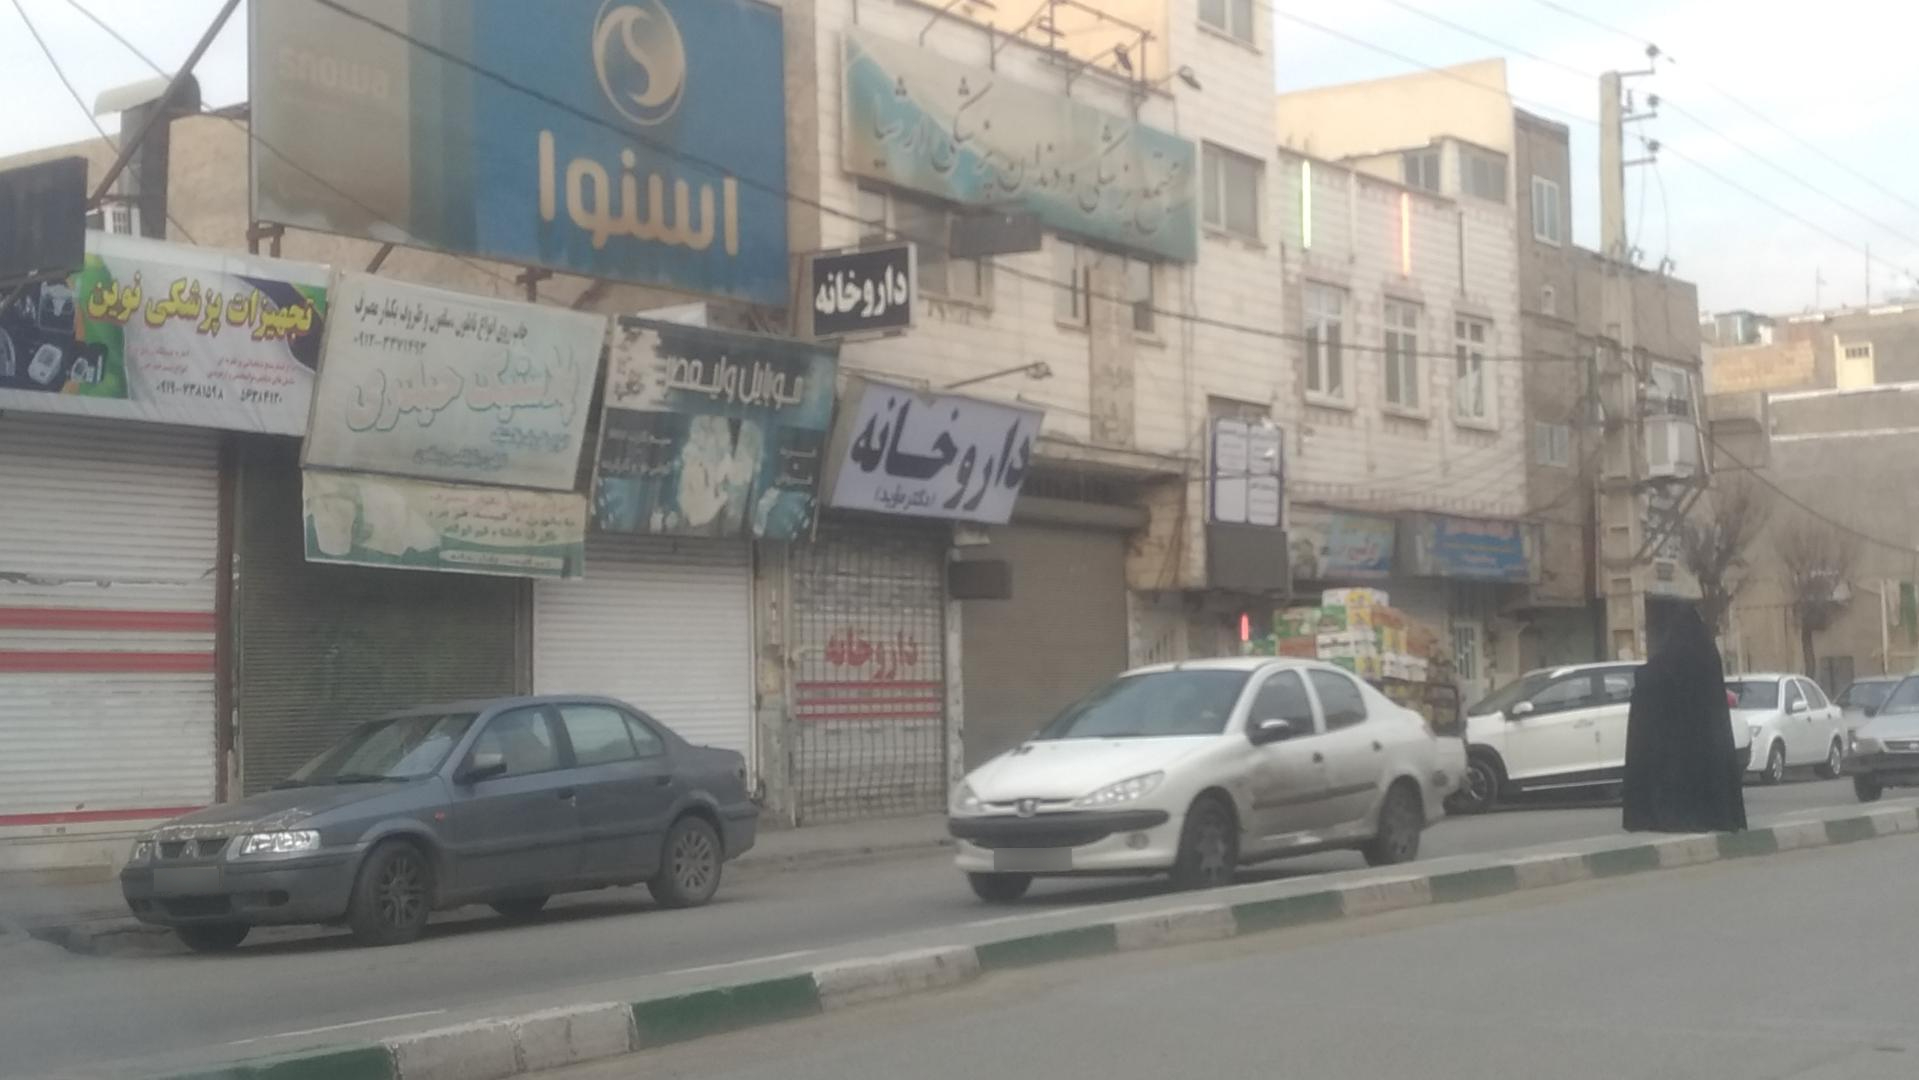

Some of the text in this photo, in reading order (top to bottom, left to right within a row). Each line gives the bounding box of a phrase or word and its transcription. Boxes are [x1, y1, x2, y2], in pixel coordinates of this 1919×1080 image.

[930, 76, 995, 198] پزشکی
[537, 128, 739, 257] اسنوا
[87, 269, 313, 340] تجهیزات پزشکی نوین
[815, 264, 907, 317] داروخانه
[737, 360, 804, 410] موبایل
[851, 397, 1031, 512] داروخانه
[824, 626, 919, 680] داروخانه
